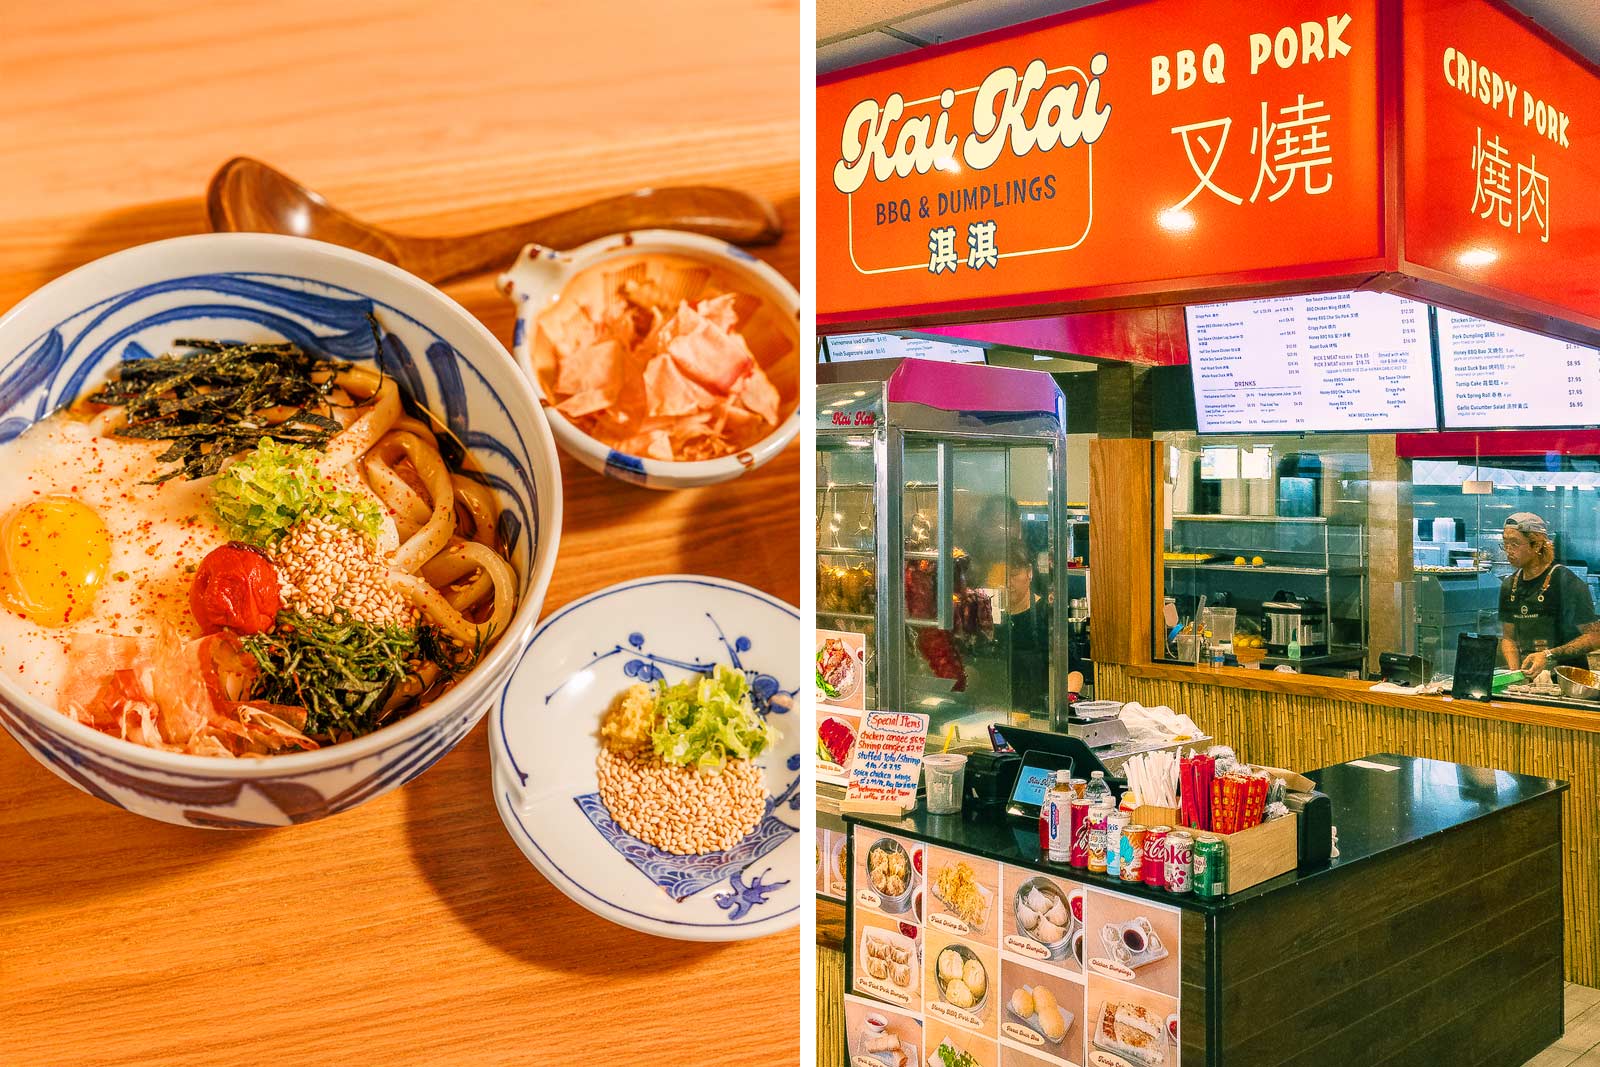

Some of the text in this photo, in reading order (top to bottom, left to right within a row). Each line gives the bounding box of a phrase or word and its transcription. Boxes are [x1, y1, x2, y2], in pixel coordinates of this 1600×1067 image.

[1151, 13, 1352, 95] BBQ PORK
[1443, 47, 1570, 149] CRISPY PORK
[833, 52, 1112, 194] Kai Kai
[1171, 94, 1333, 210] 叉燒
[876, 175, 1056, 225] BBQ & DUMPLINGS
[1470, 127, 1550, 243] 燒肉
[832, 410, 875, 426] Kai Kai
[871, 714, 920, 728] Special Items
